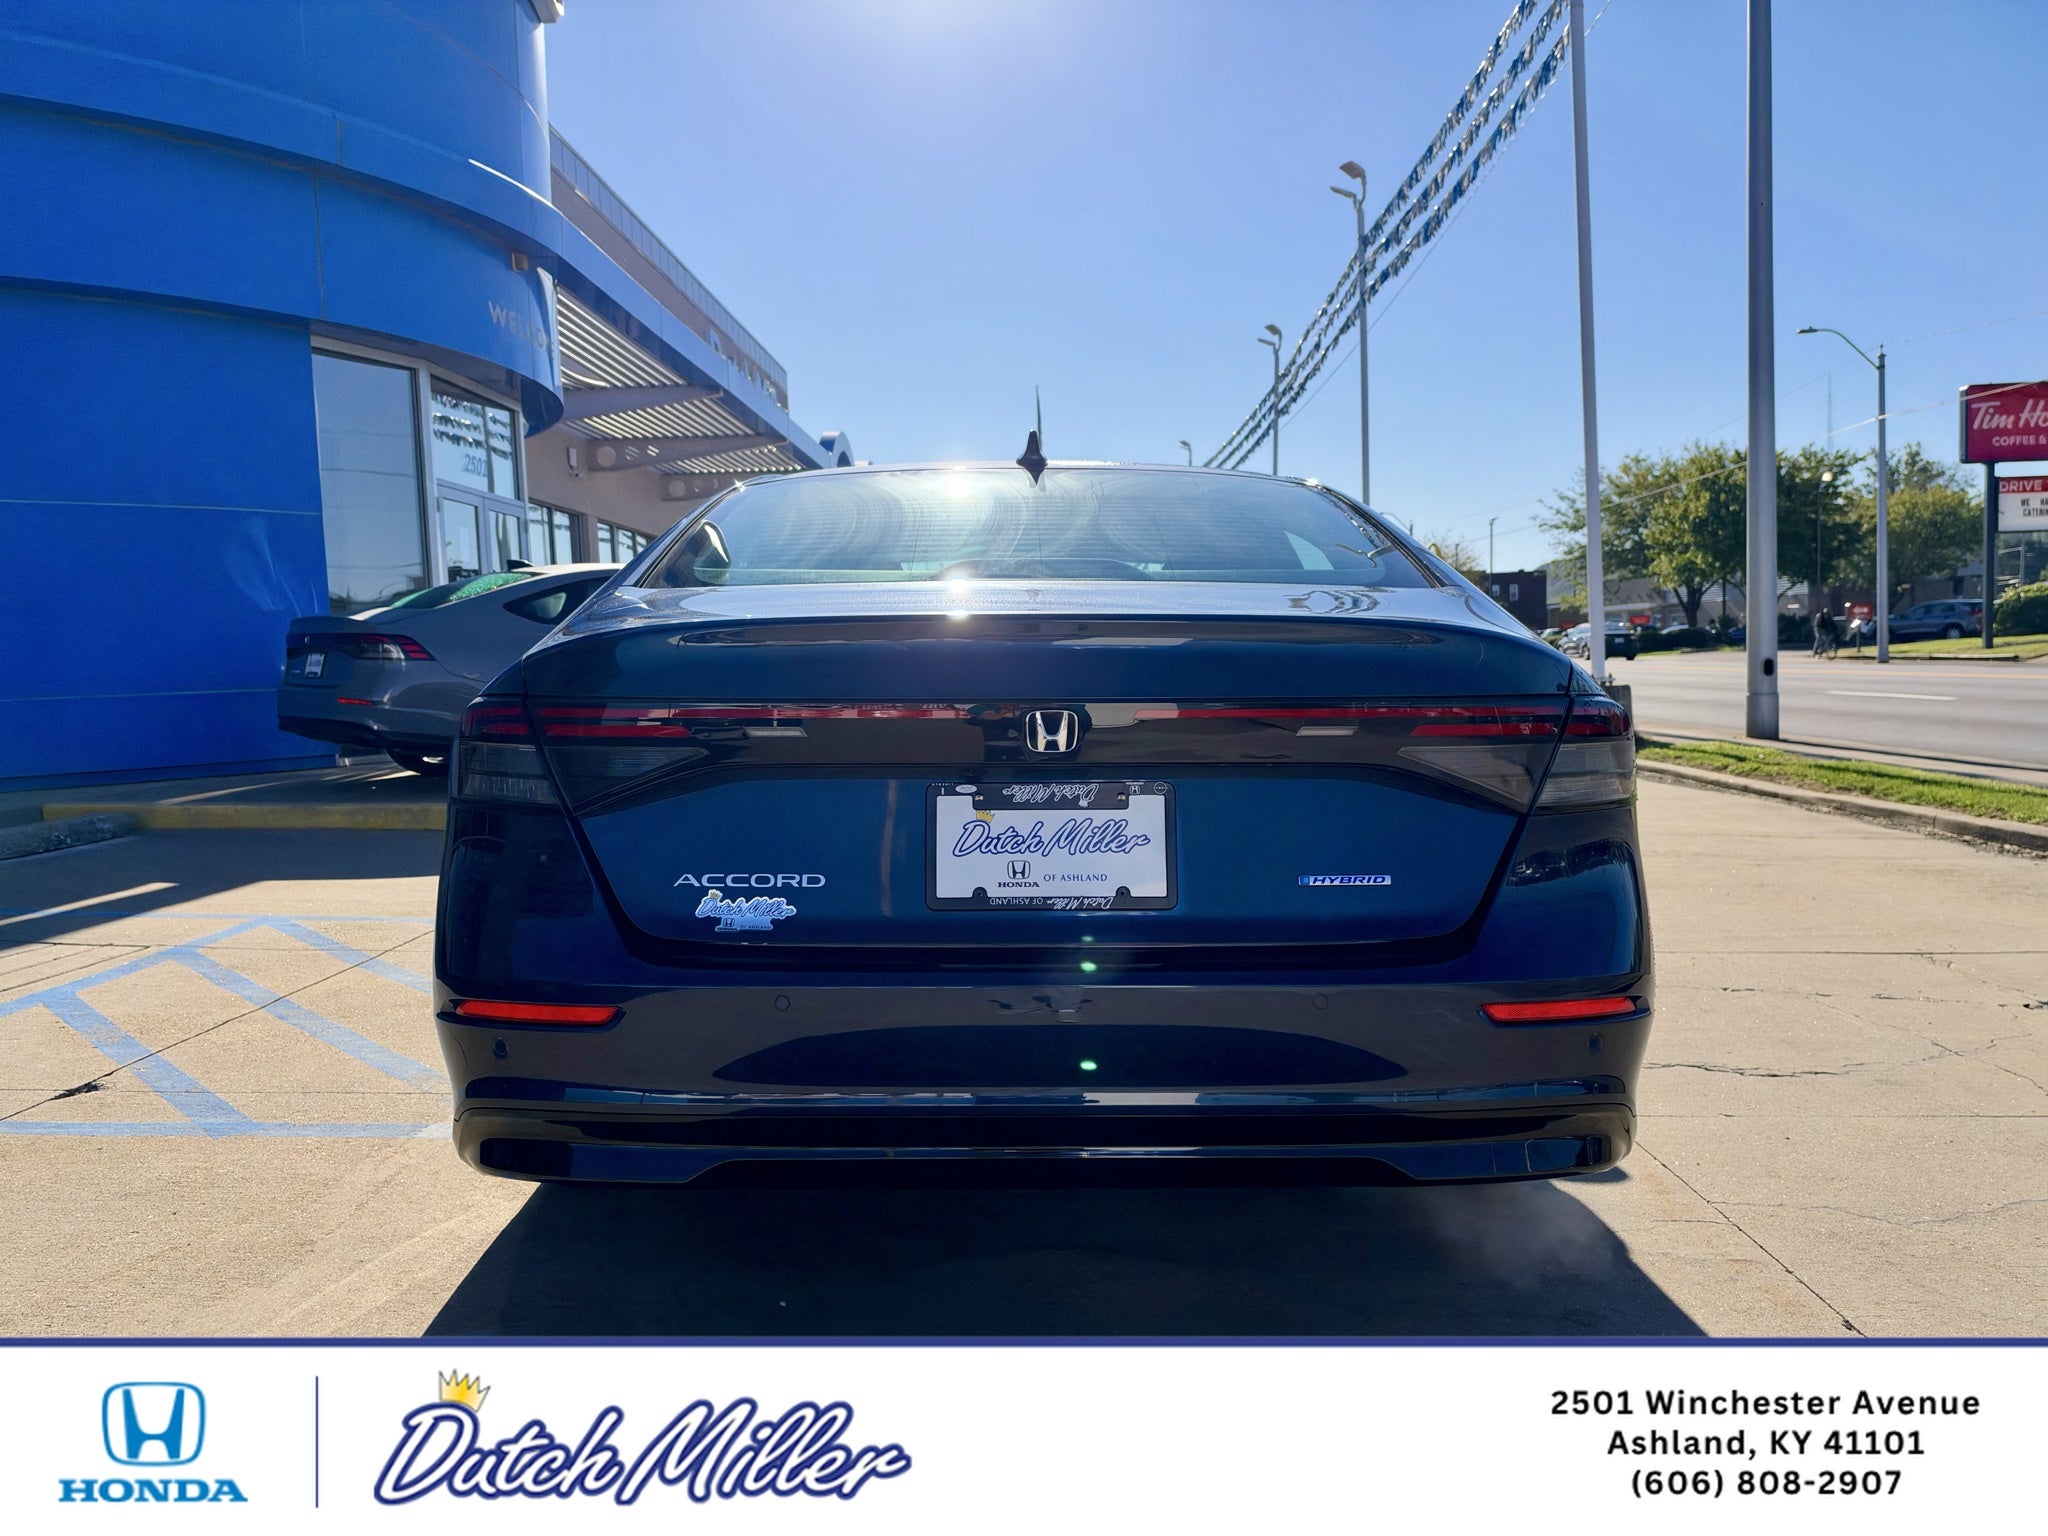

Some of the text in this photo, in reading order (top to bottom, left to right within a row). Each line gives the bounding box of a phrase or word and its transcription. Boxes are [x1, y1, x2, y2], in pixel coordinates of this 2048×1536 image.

[1971, 401, 2015, 430] Tim
[1992, 434, 2047, 446] COFFEE &
[464, 454, 488, 478] 2501
[2000, 480, 2043, 492] DRIVE
[1002, 783, 1100, 803] Dutch Miller
[952, 818, 1151, 857] Dutch Miller
[673, 873, 826, 888] ACCORD
[1043, 873, 1108, 882] OF ASHLAND
[1312, 876, 1386, 885] HYBRID
[700, 898, 795, 918] Dutch Miller
[990, 896, 1114, 910] Dutch Miller OF ASHLAND
